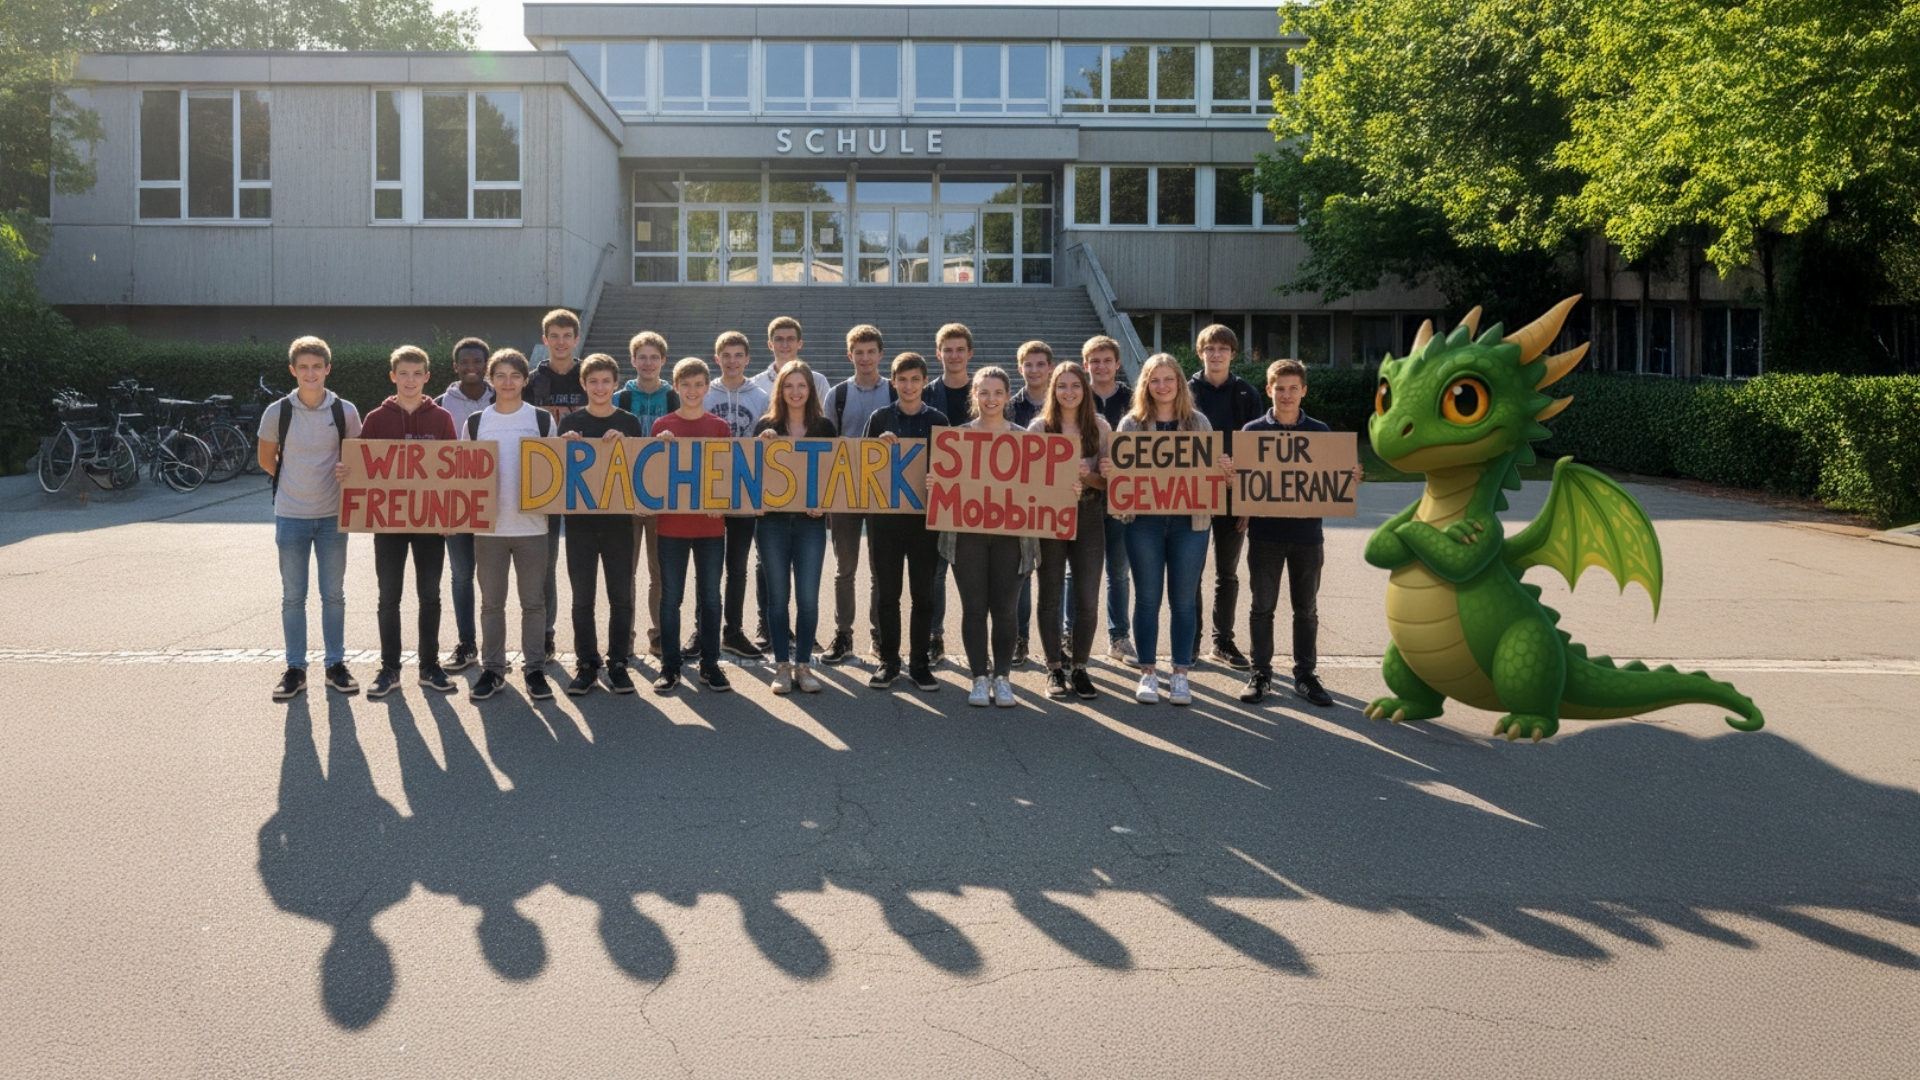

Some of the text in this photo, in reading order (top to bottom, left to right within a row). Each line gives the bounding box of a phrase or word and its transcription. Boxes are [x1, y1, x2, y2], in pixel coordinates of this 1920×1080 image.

[776, 129, 942, 153] SCHULE
[932, 430, 1074, 486] STOPP
[1111, 435, 1213, 469] GEGEN
[1258, 432, 1313, 463] FÜR
[520, 439, 926, 511] DRACHENSTARK
[1109, 475, 1225, 511] GEWALT
[1235, 469, 1354, 503] TOLERANZ
[340, 487, 490, 529] FREUNDE
[927, 481, 1077, 541] Mobbing
